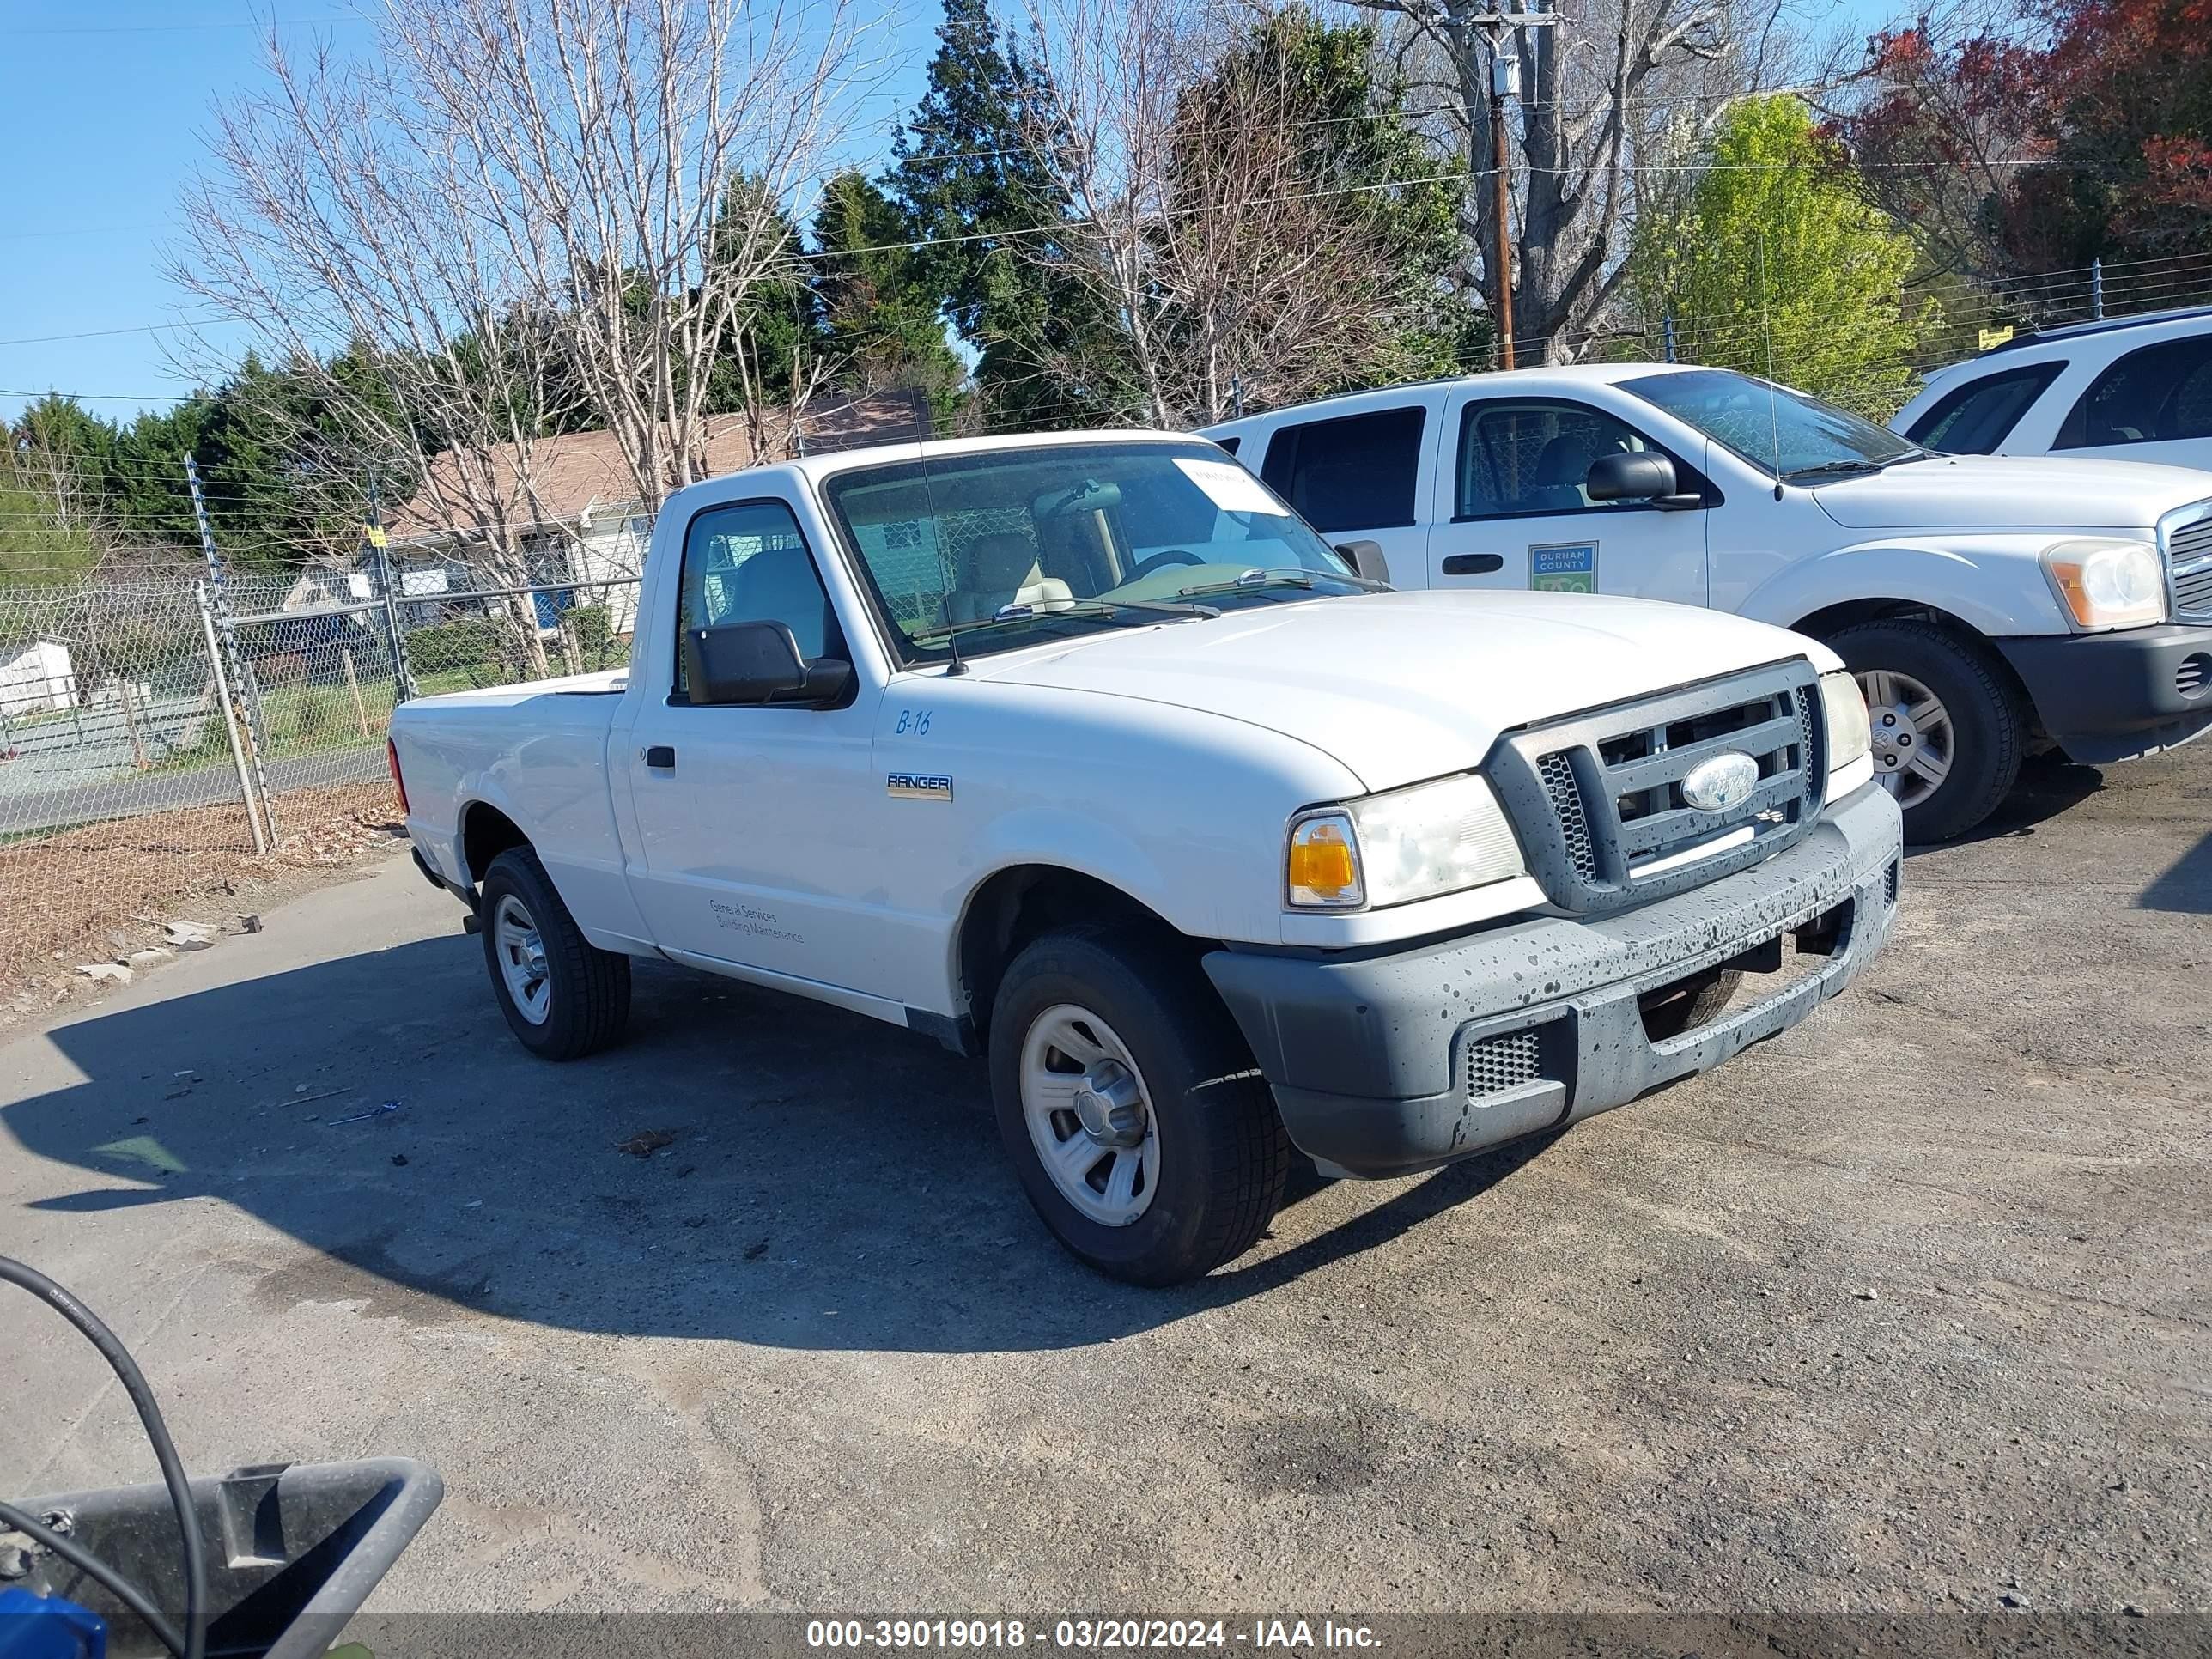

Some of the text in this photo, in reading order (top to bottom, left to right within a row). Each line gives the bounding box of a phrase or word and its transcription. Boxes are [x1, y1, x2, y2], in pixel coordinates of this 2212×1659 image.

[1540, 551, 1585, 561] DURHAM
[1540, 561, 1585, 570] COUNTY
[896, 709, 933, 736] B-16
[887, 775, 950, 791] RANGER
[709, 899, 777, 923] General Services
[749, 922, 805, 944] Maintenance
